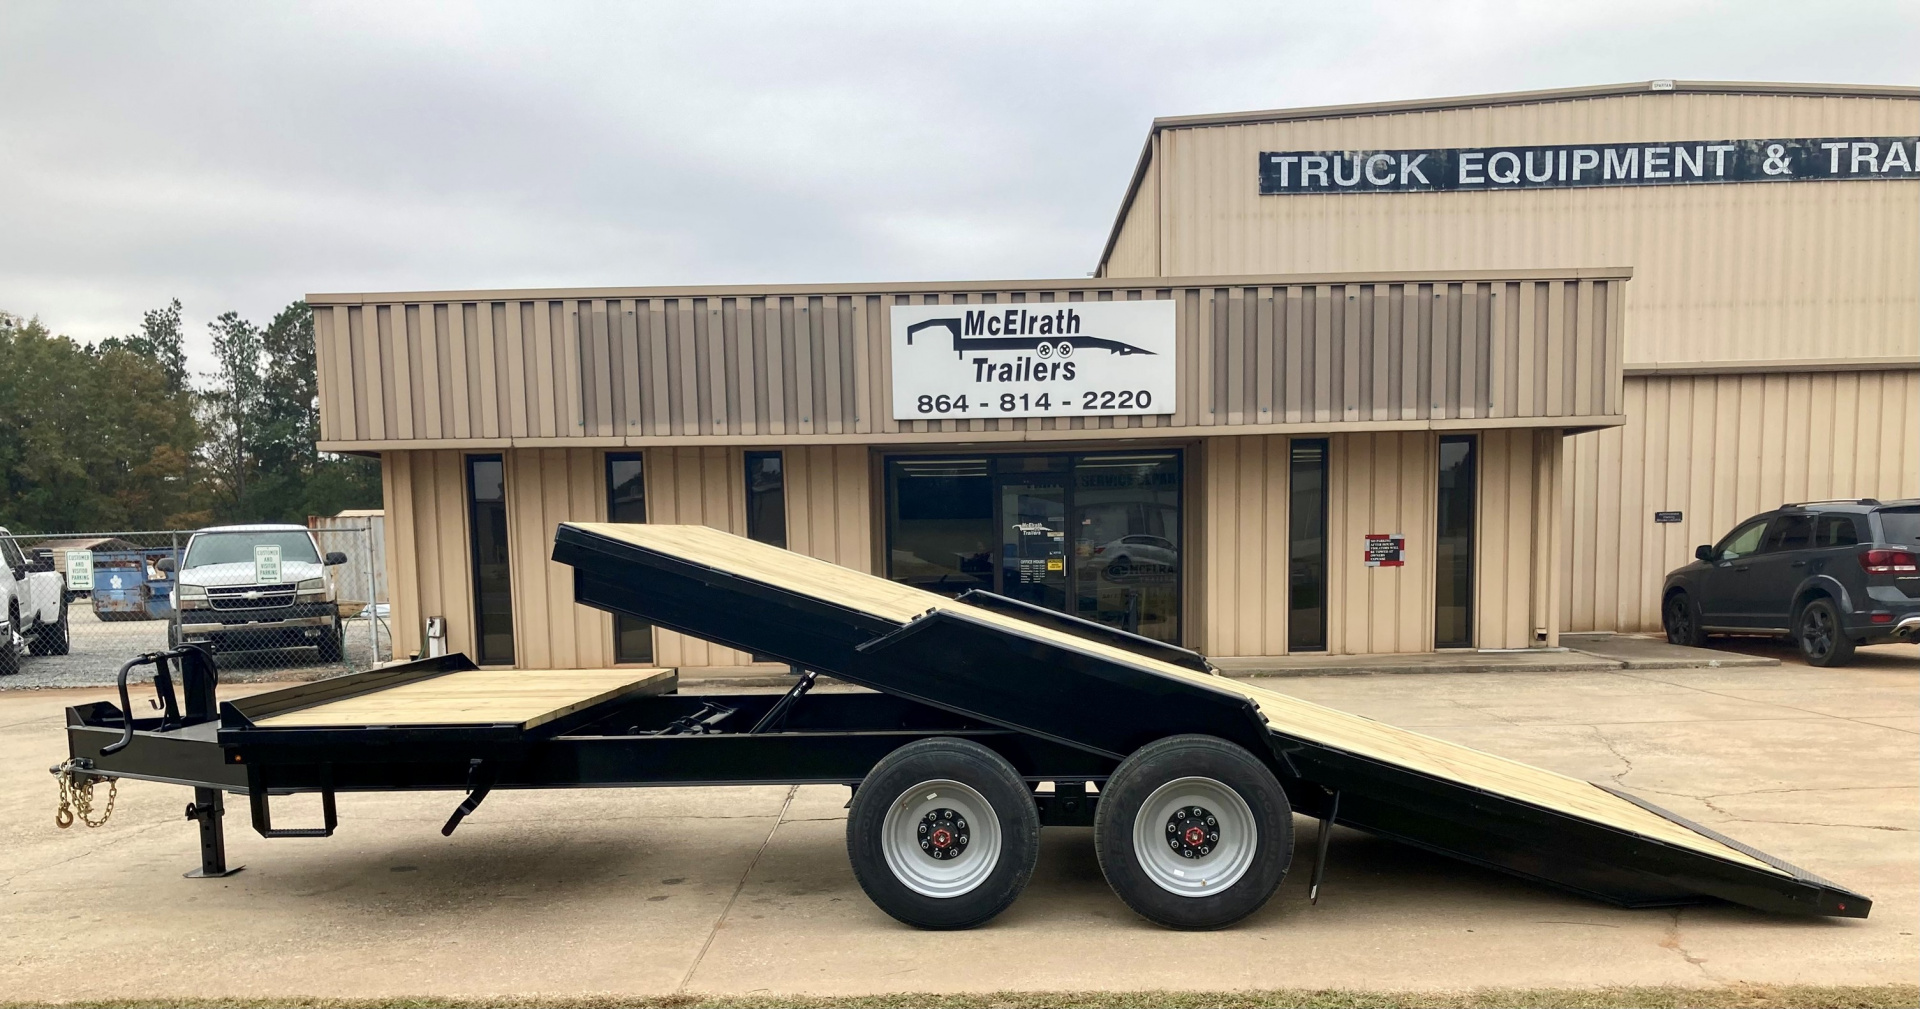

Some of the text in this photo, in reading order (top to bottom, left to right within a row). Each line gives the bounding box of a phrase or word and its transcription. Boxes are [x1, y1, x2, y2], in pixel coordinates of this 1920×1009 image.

[1271, 153, 1430, 187] TRUCK
[1459, 145, 1735, 184] EQUIPMENT
[1762, 144, 1793, 175] &
[964, 308, 1081, 336] McElrath
[972, 356, 1076, 383] Trailers
[917, 394, 969, 414] 864
[999, 392, 1051, 412] 814
[1082, 390, 1152, 410] 2220
